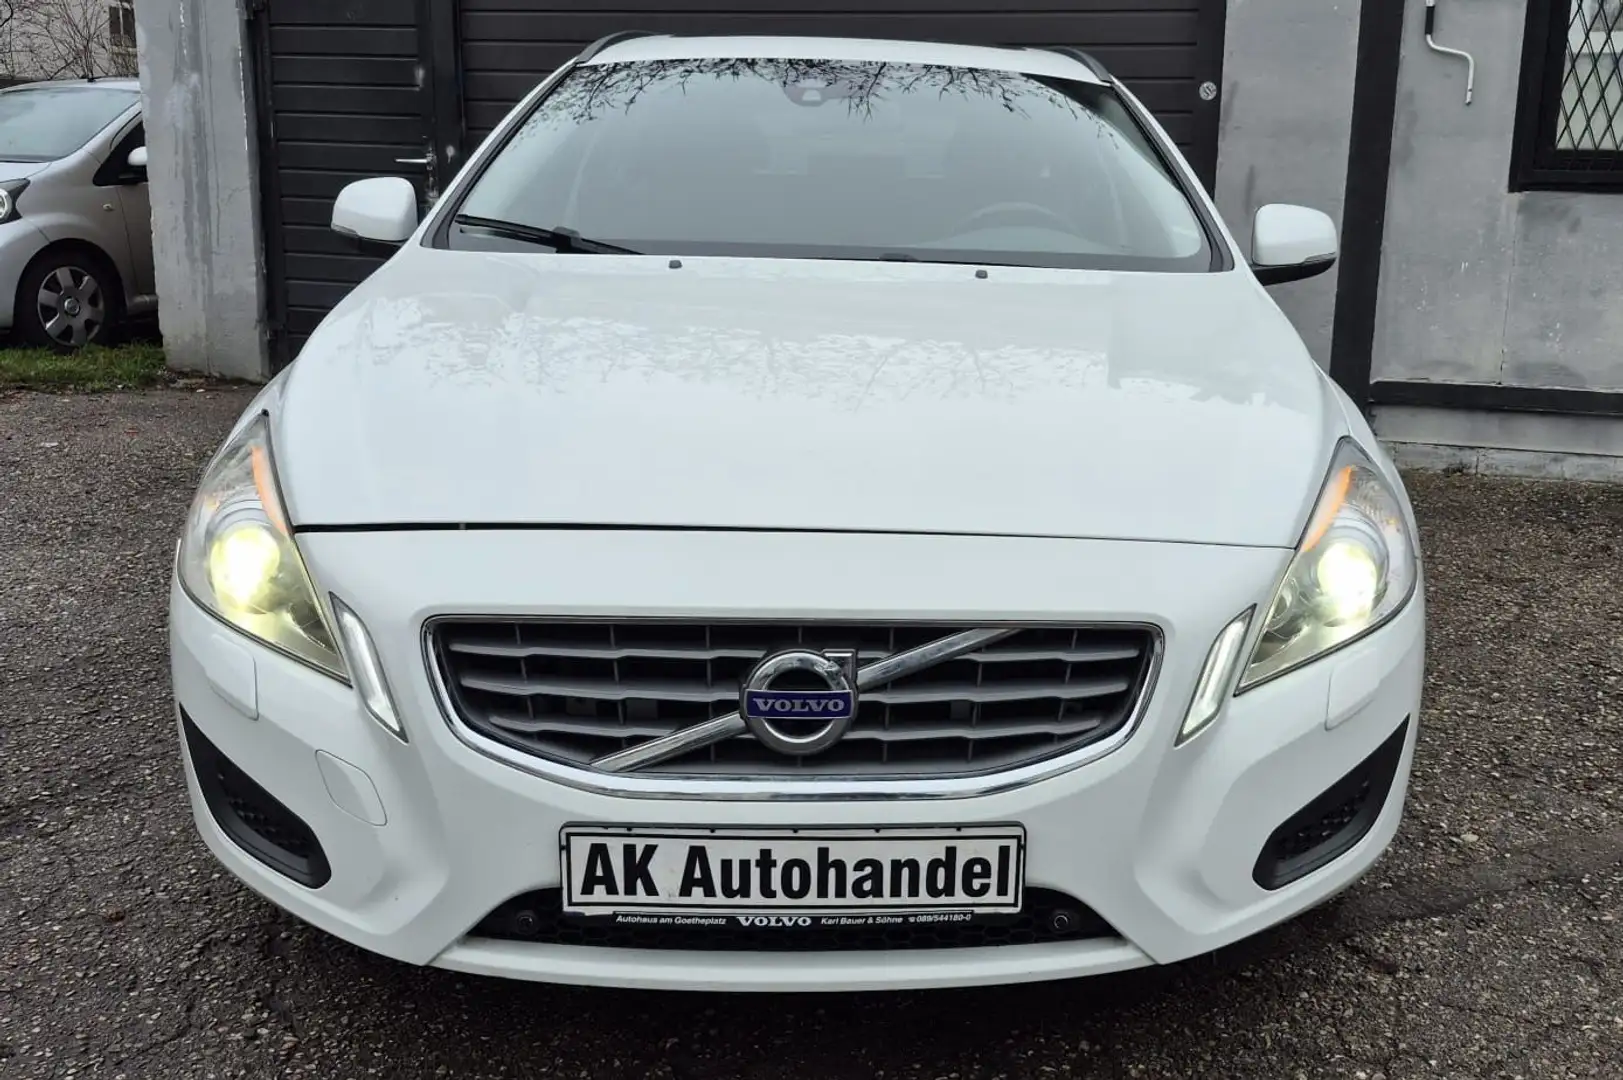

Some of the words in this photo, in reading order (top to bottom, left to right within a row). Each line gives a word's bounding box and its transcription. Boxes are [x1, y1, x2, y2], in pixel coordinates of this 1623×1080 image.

[752, 697, 846, 712] VOLVO
[580, 842, 660, 897] AK
[678, 844, 1011, 899] Autohandel
[616, 914, 658, 924] Autohaus
[659, 916, 673, 924] am
[674, 915, 727, 926] Goetheplatz
[736, 916, 812, 926] VOLVO
[820, 916, 839, 925] Karl
[840, 916, 866, 925] Bauer
[867, 916, 874, 924] &
[875, 915, 904, 924] Söhne
